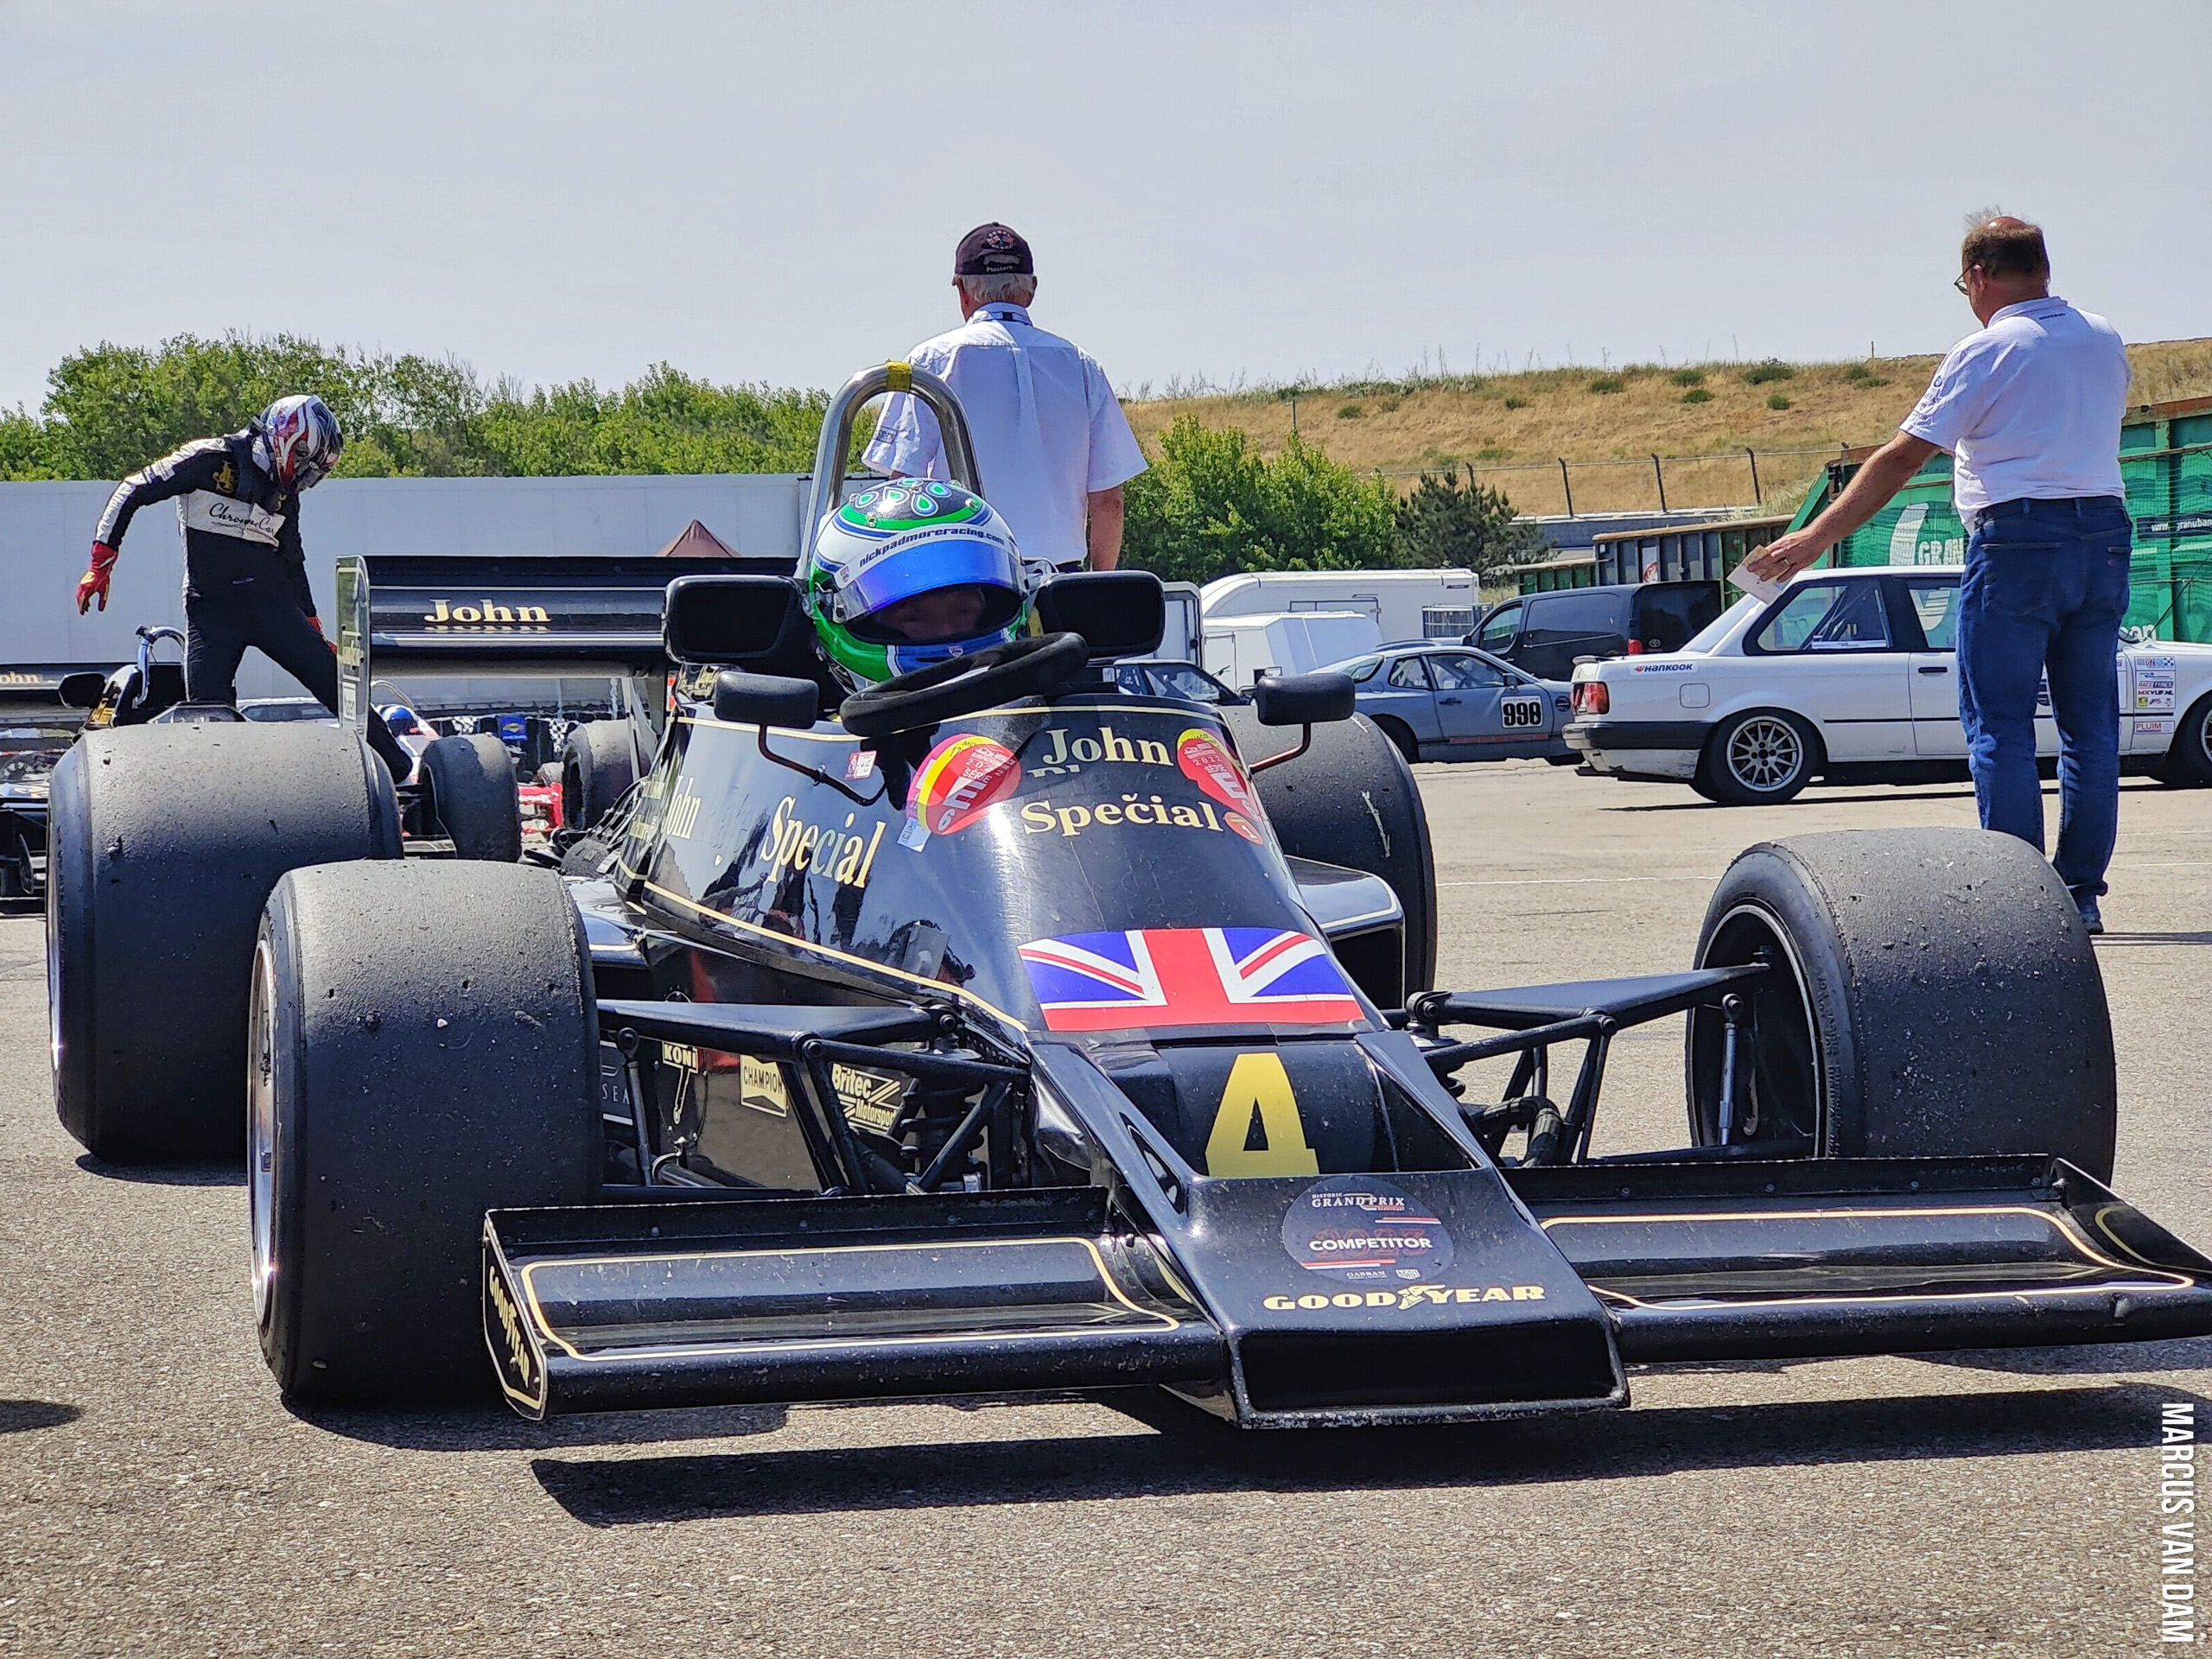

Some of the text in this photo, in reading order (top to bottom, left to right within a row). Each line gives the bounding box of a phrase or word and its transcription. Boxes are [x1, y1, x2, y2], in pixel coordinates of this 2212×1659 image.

[859, 527, 1005, 569] nickpadmoreracing.com
[423, 598, 552, 623] John
[0, 671, 41, 684] ohn
[1503, 702, 1541, 726] 998
[1042, 727, 1174, 766] John
[965, 758, 1004, 777] 2022
[1193, 756, 1223, 766] 2022
[662, 776, 701, 840] John
[760, 796, 887, 888] Special
[664, 1043, 696, 1069] KONI
[743, 1065, 783, 1095] CHAMPION
[832, 1063, 872, 1099] Britec
[1205, 1052, 1319, 1178] 4
[1312, 1197, 1405, 1208] GRAND PRIX
[1309, 1237, 1433, 1251] COMPETITOR
[1263, 1285, 1546, 1310] GOODYEAR
